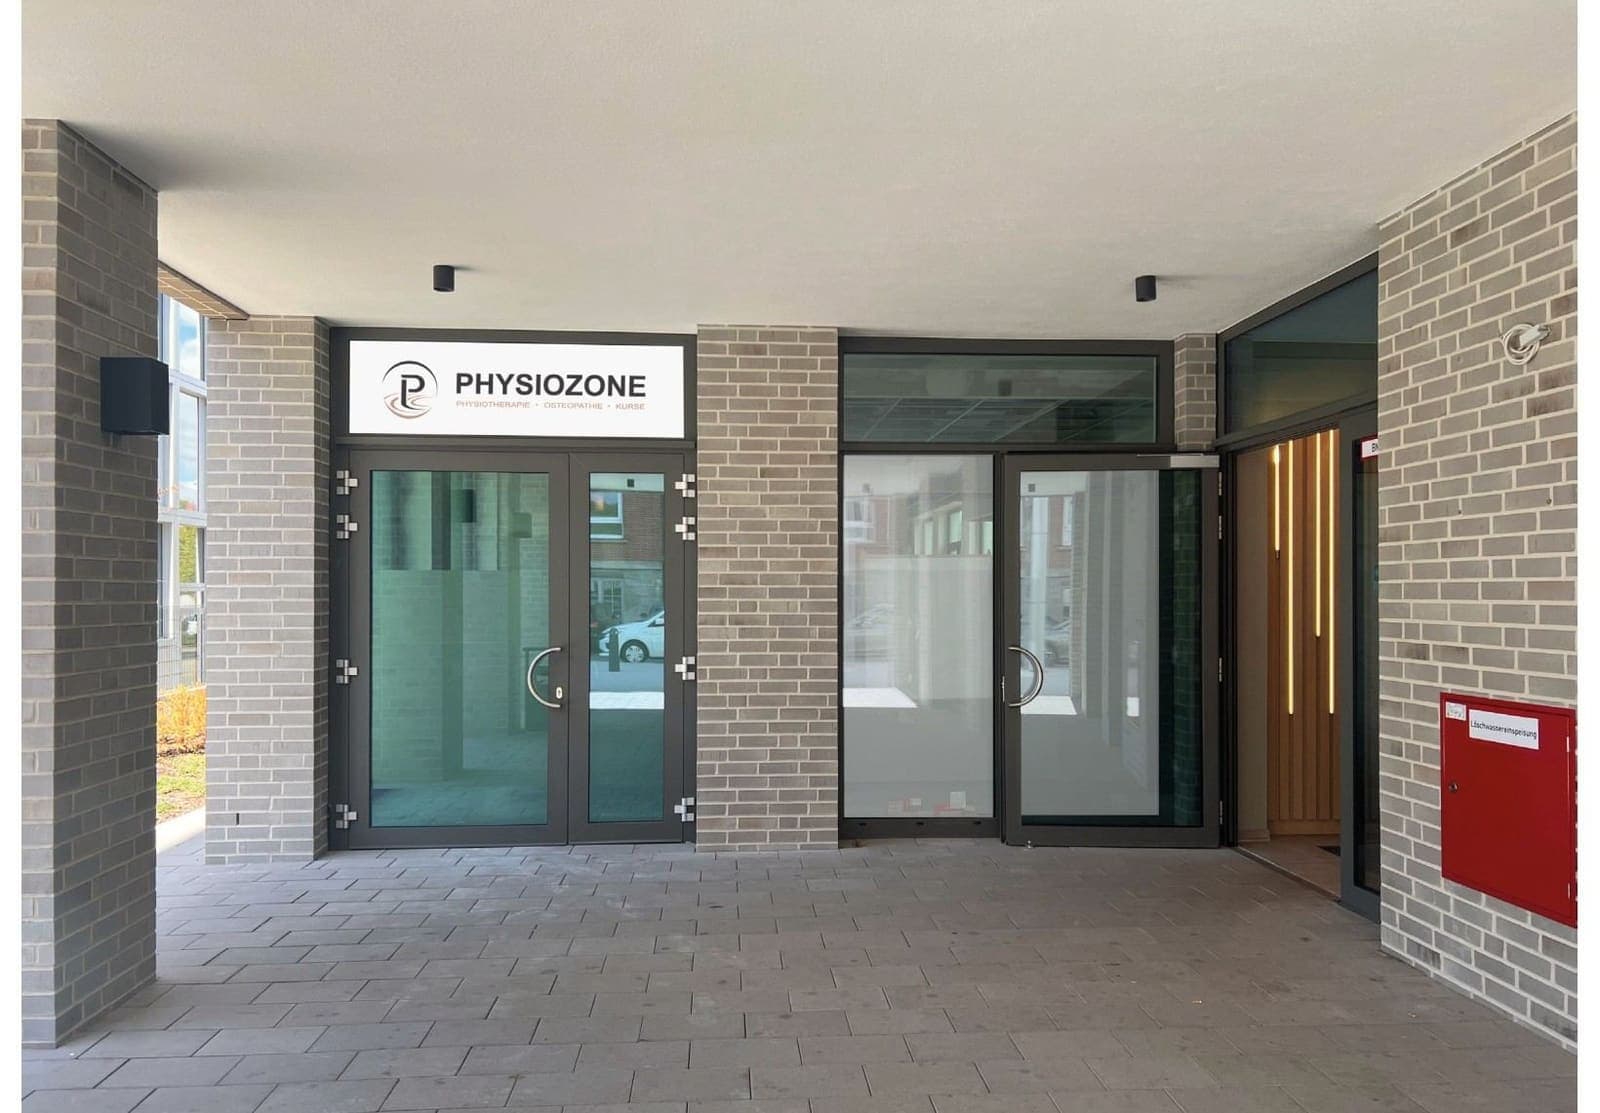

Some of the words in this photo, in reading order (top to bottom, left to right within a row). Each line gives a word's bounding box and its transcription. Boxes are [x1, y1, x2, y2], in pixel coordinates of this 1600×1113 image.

[455, 372, 647, 398] PHYSIOZONE
[455, 400, 531, 409] PHYSIOTHERAPIE
[543, 401, 603, 410] OSTEOPATHIE
[615, 402, 646, 411] KURSE
[1470, 719, 1538, 740] Löschwassereinspeisung
